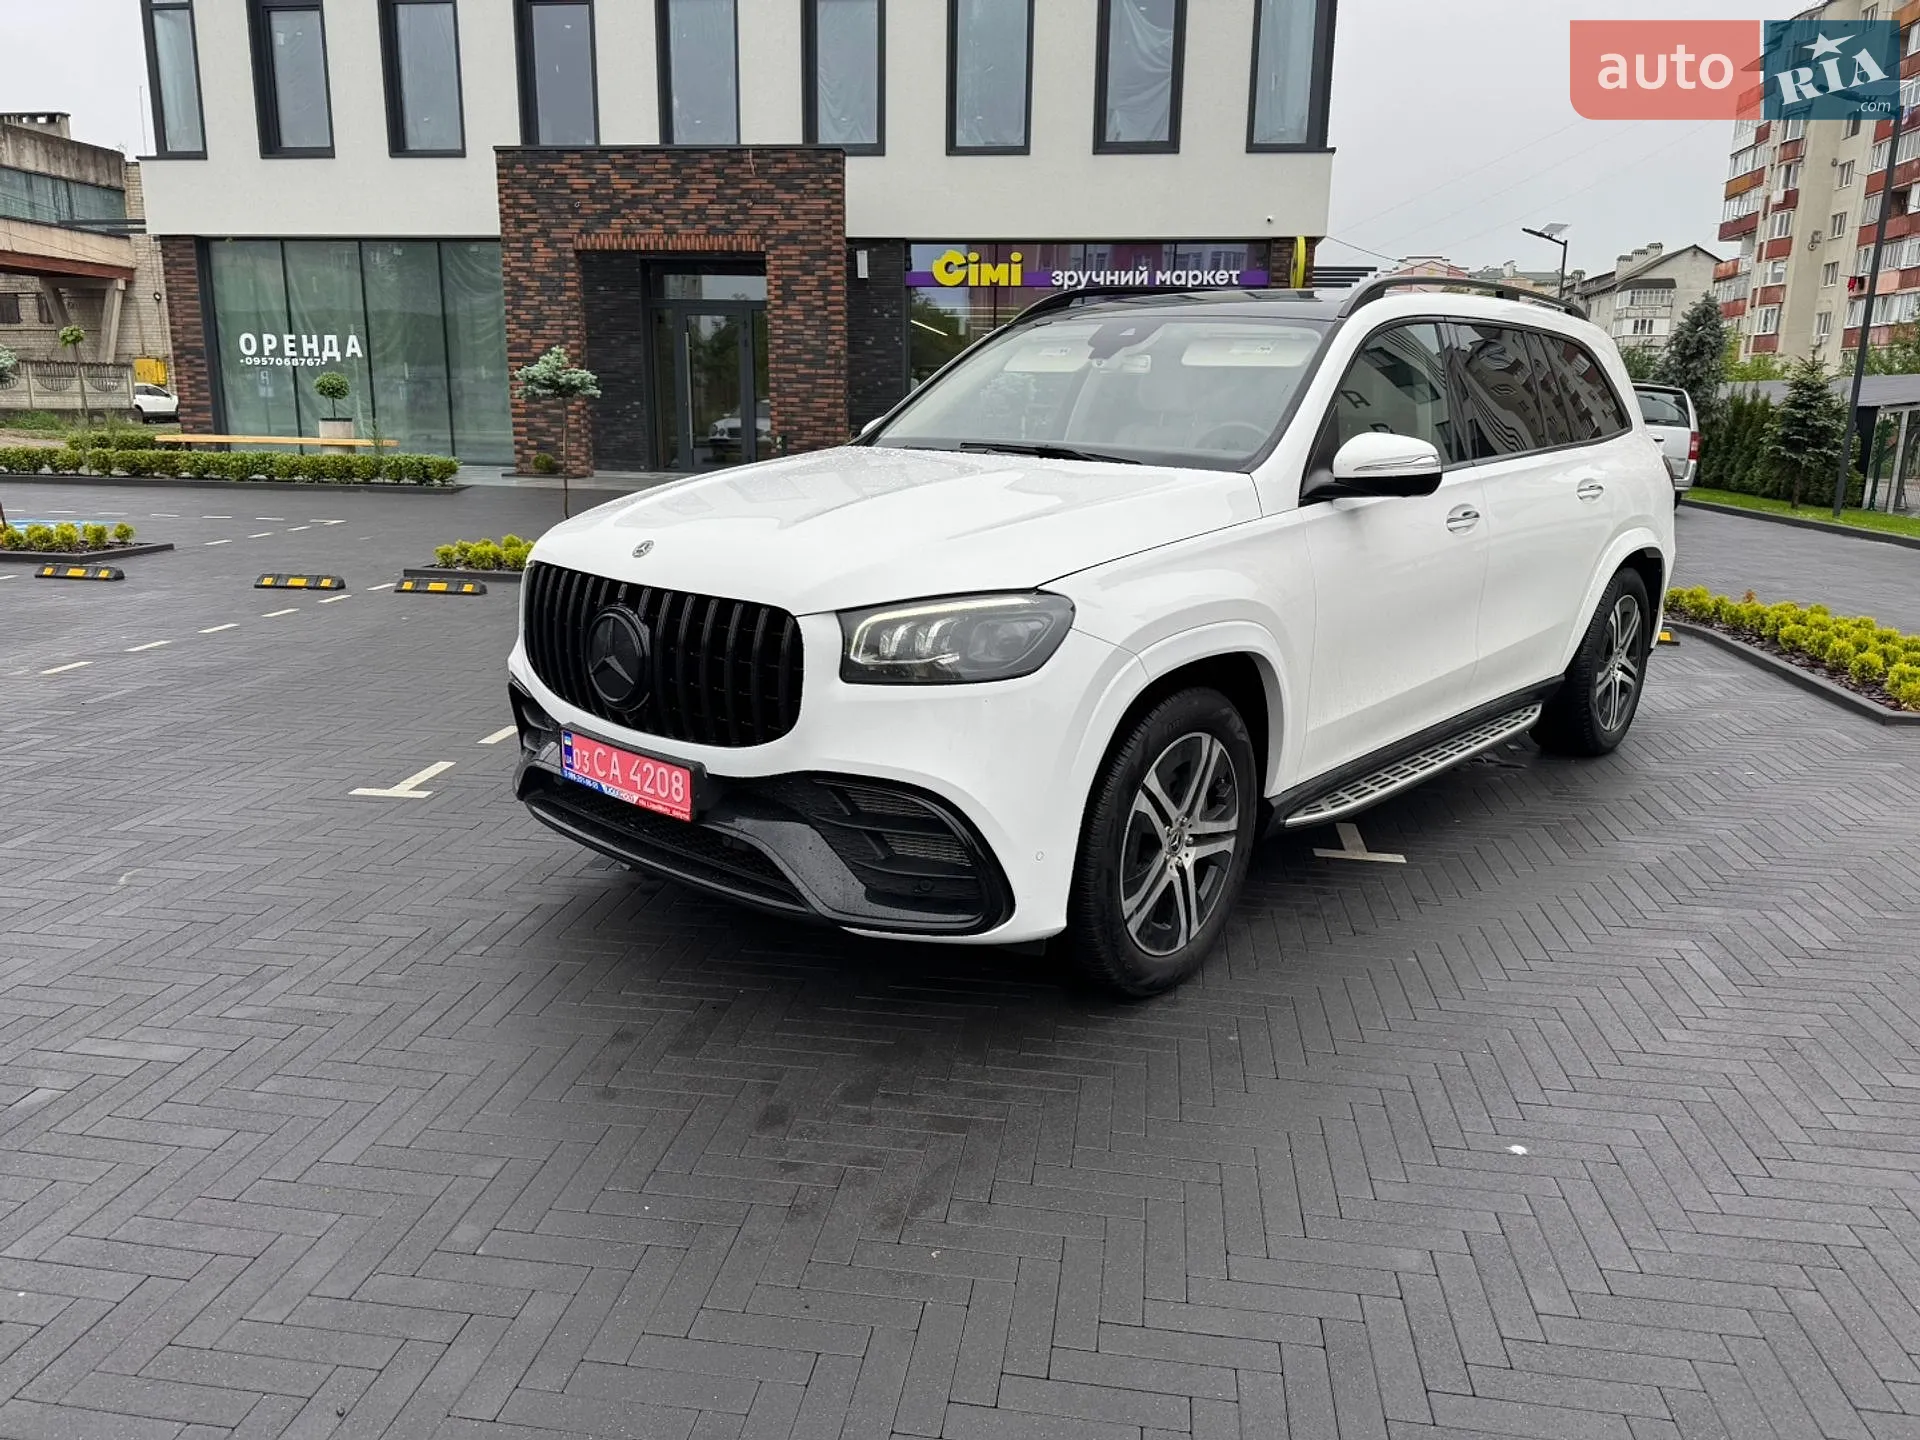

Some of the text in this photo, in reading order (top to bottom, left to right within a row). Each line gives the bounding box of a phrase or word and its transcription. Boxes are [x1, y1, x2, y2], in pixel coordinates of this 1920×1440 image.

[1051, 266, 1148, 291] зручний
[1155, 270, 1240, 288] маркет
[239, 332, 363, 362] ОРЕНДА
[629, 759, 684, 803] 4208
